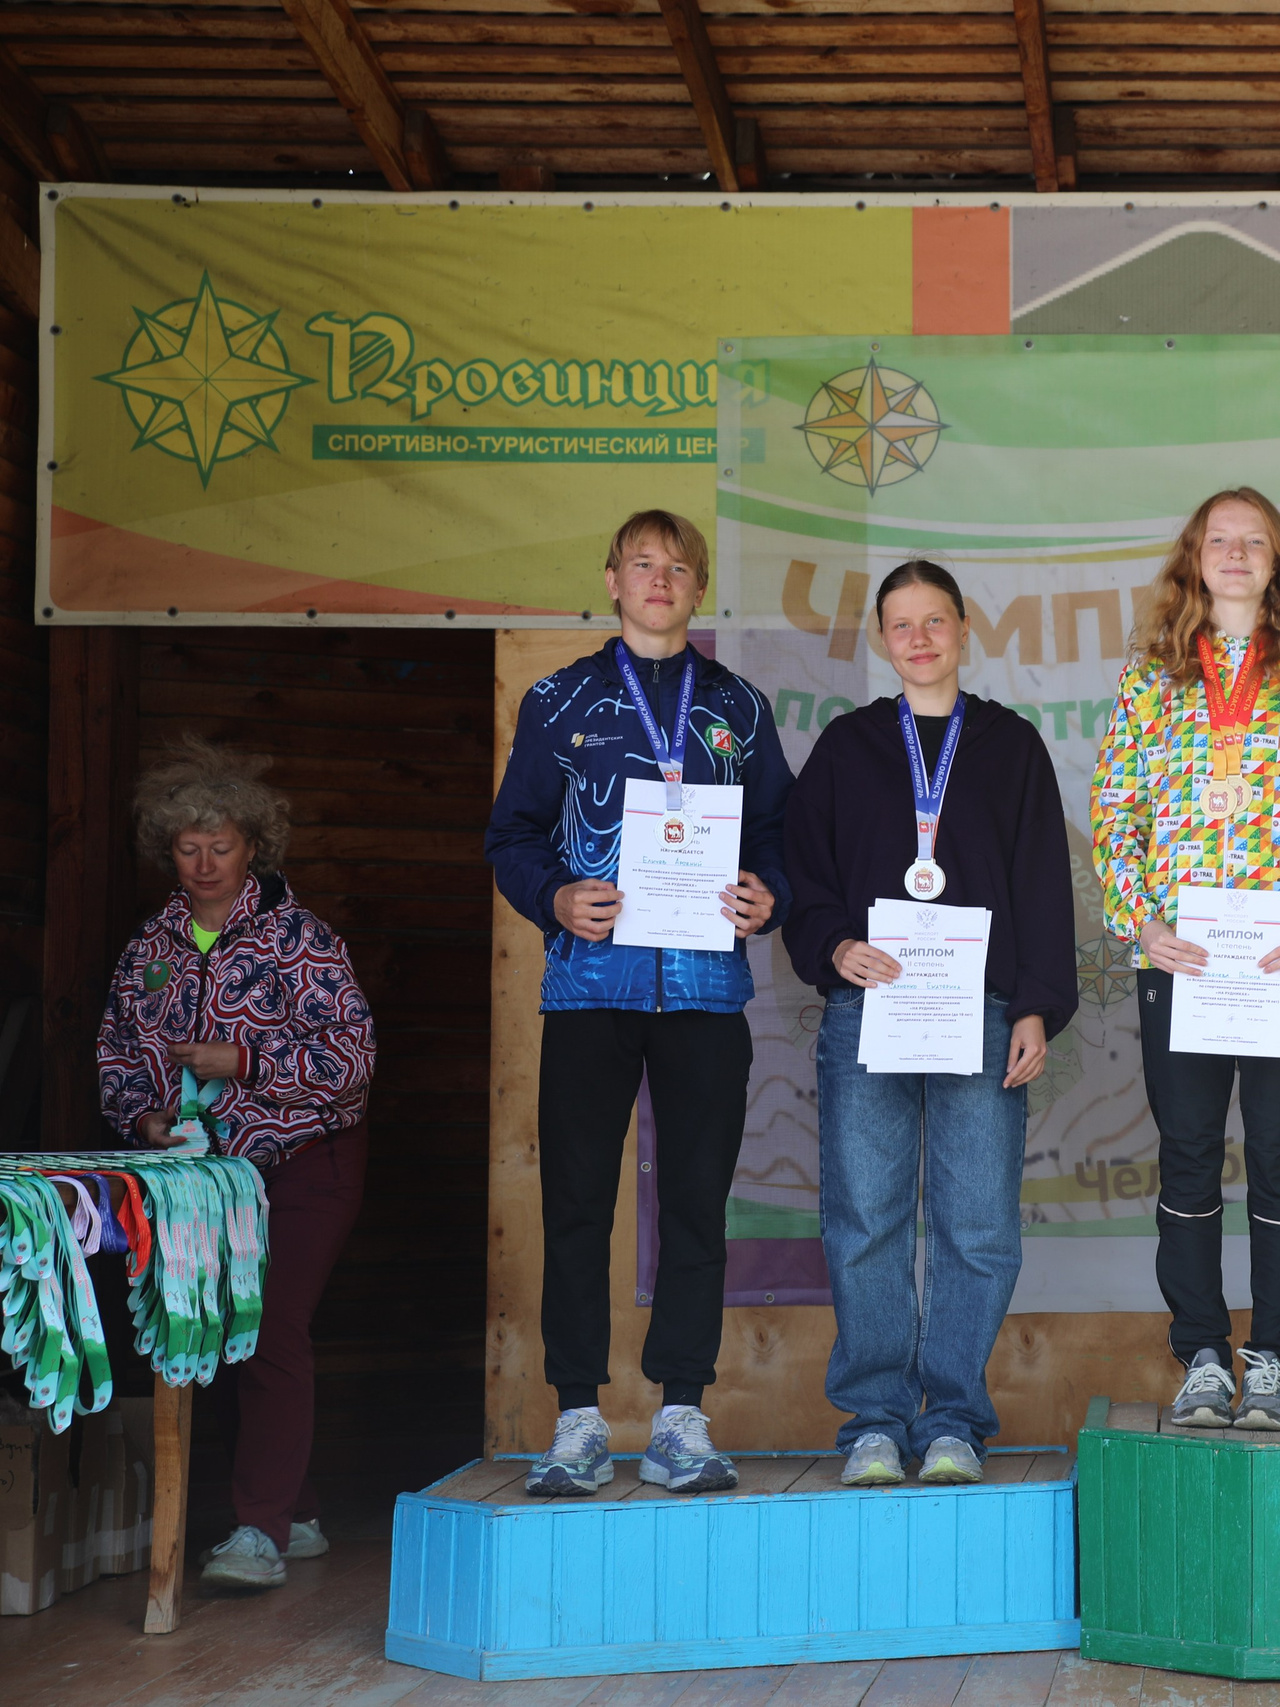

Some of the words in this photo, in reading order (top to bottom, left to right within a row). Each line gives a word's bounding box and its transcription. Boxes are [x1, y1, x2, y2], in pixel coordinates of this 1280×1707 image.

[328, 433, 670, 455] СПОРТИВНО-ТУРИСТИЧЕСКИЙ
[676, 435, 749, 456] ЦЕНР
[623, 663, 642, 695] ОБЛАСТЬ
[680, 663, 693, 711] ЧЕЛЯБИНСКАЯ
[636, 695, 661, 750] ЧЕЛЯБИНСКАЯ
[675, 712, 687, 748] ОБЛАСТЬ
[903, 714, 915, 744] ОБЛАСТЬ
[941, 715, 960, 765] ЧЕЛЯБИНСКАЯ
[908, 745, 923, 799] ЧЕЛЯБИНСКАЯ
[932, 765, 946, 799] ОБЛАСТЬ
[1207, 928, 1263, 940] ДИПЛОМ
[898, 948, 954, 958] ДИПЛОМ
